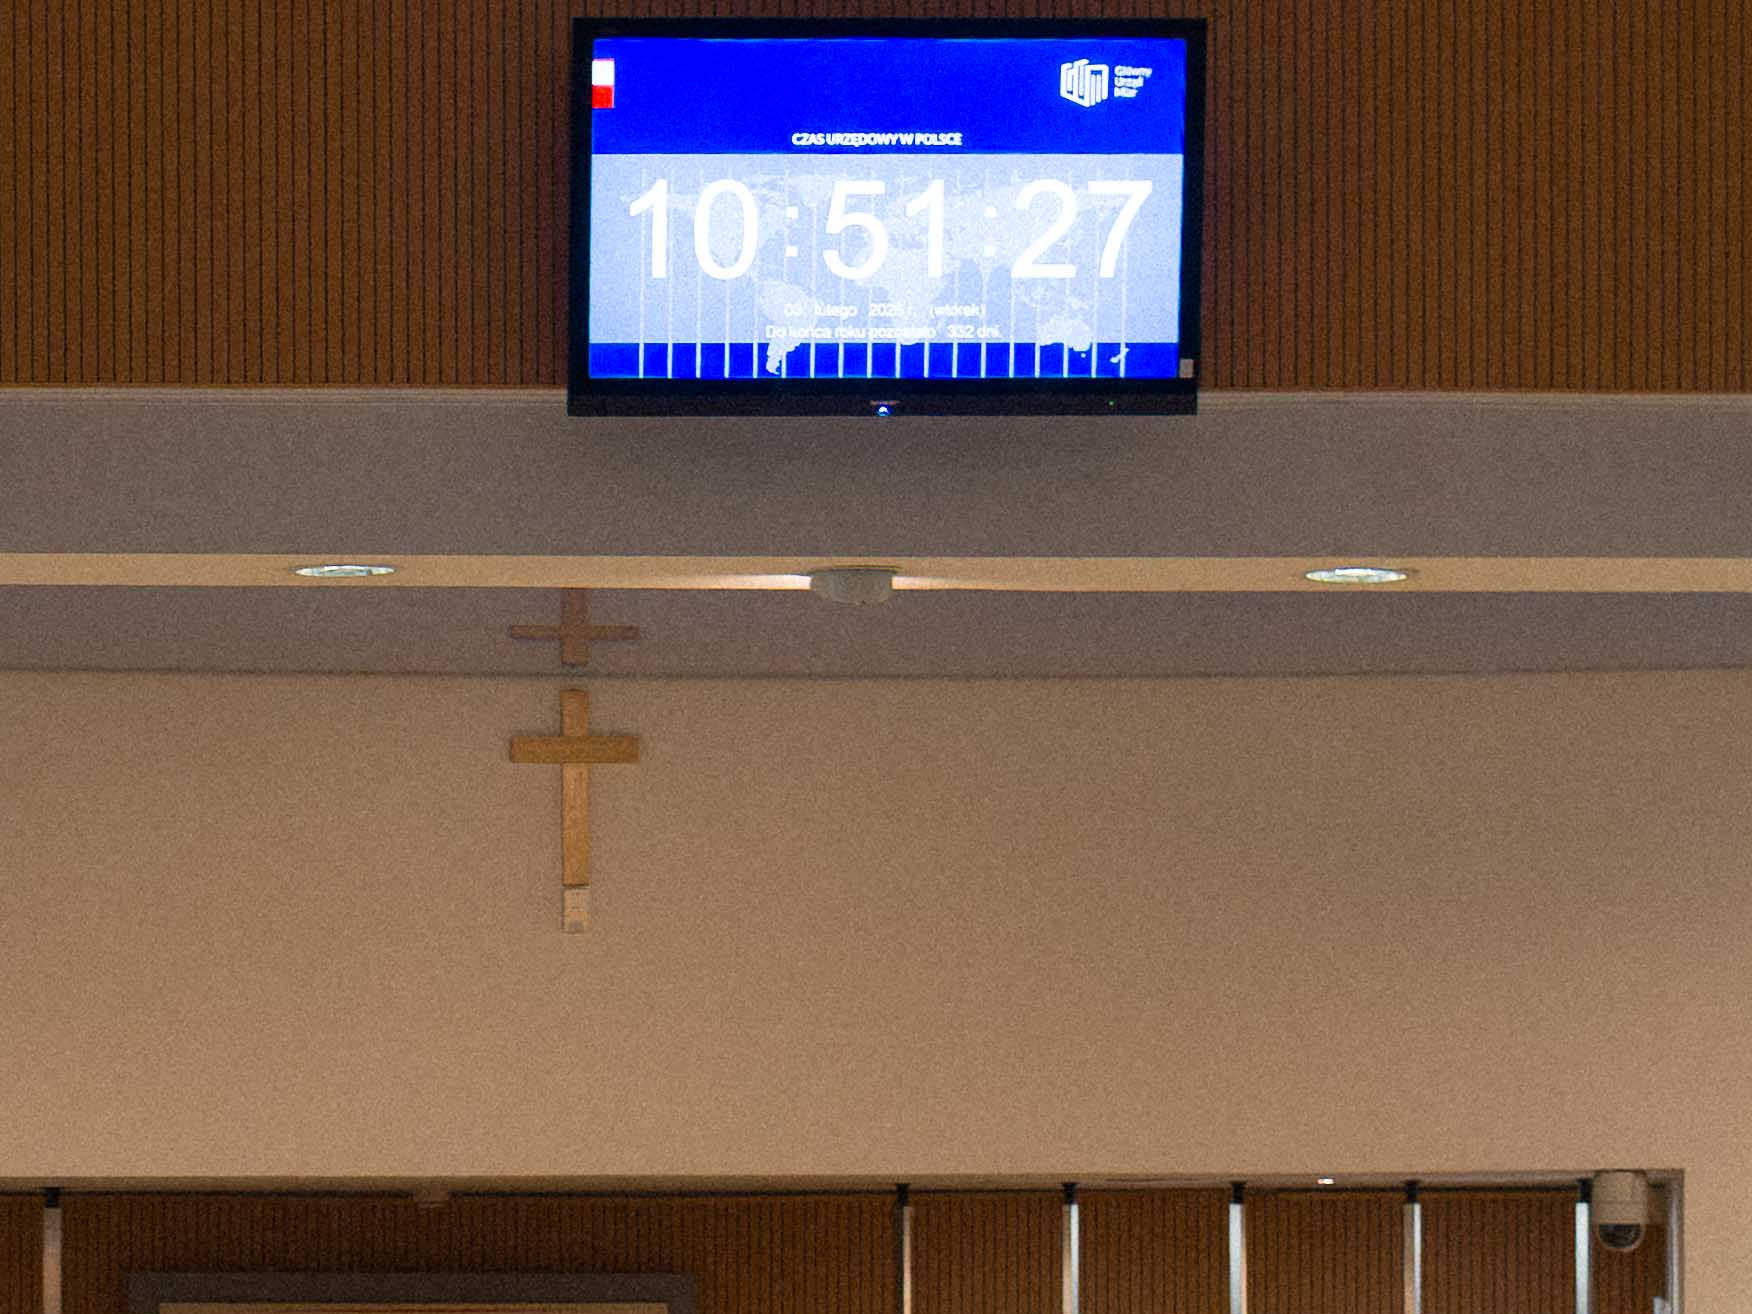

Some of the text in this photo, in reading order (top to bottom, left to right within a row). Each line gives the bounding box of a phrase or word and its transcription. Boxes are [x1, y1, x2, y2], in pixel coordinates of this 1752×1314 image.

[791, 132, 825, 146] CZAS
[895, 132, 914, 146] W
[915, 132, 963, 146] POLSCE
[628, 178, 1154, 279] 10:51:27
